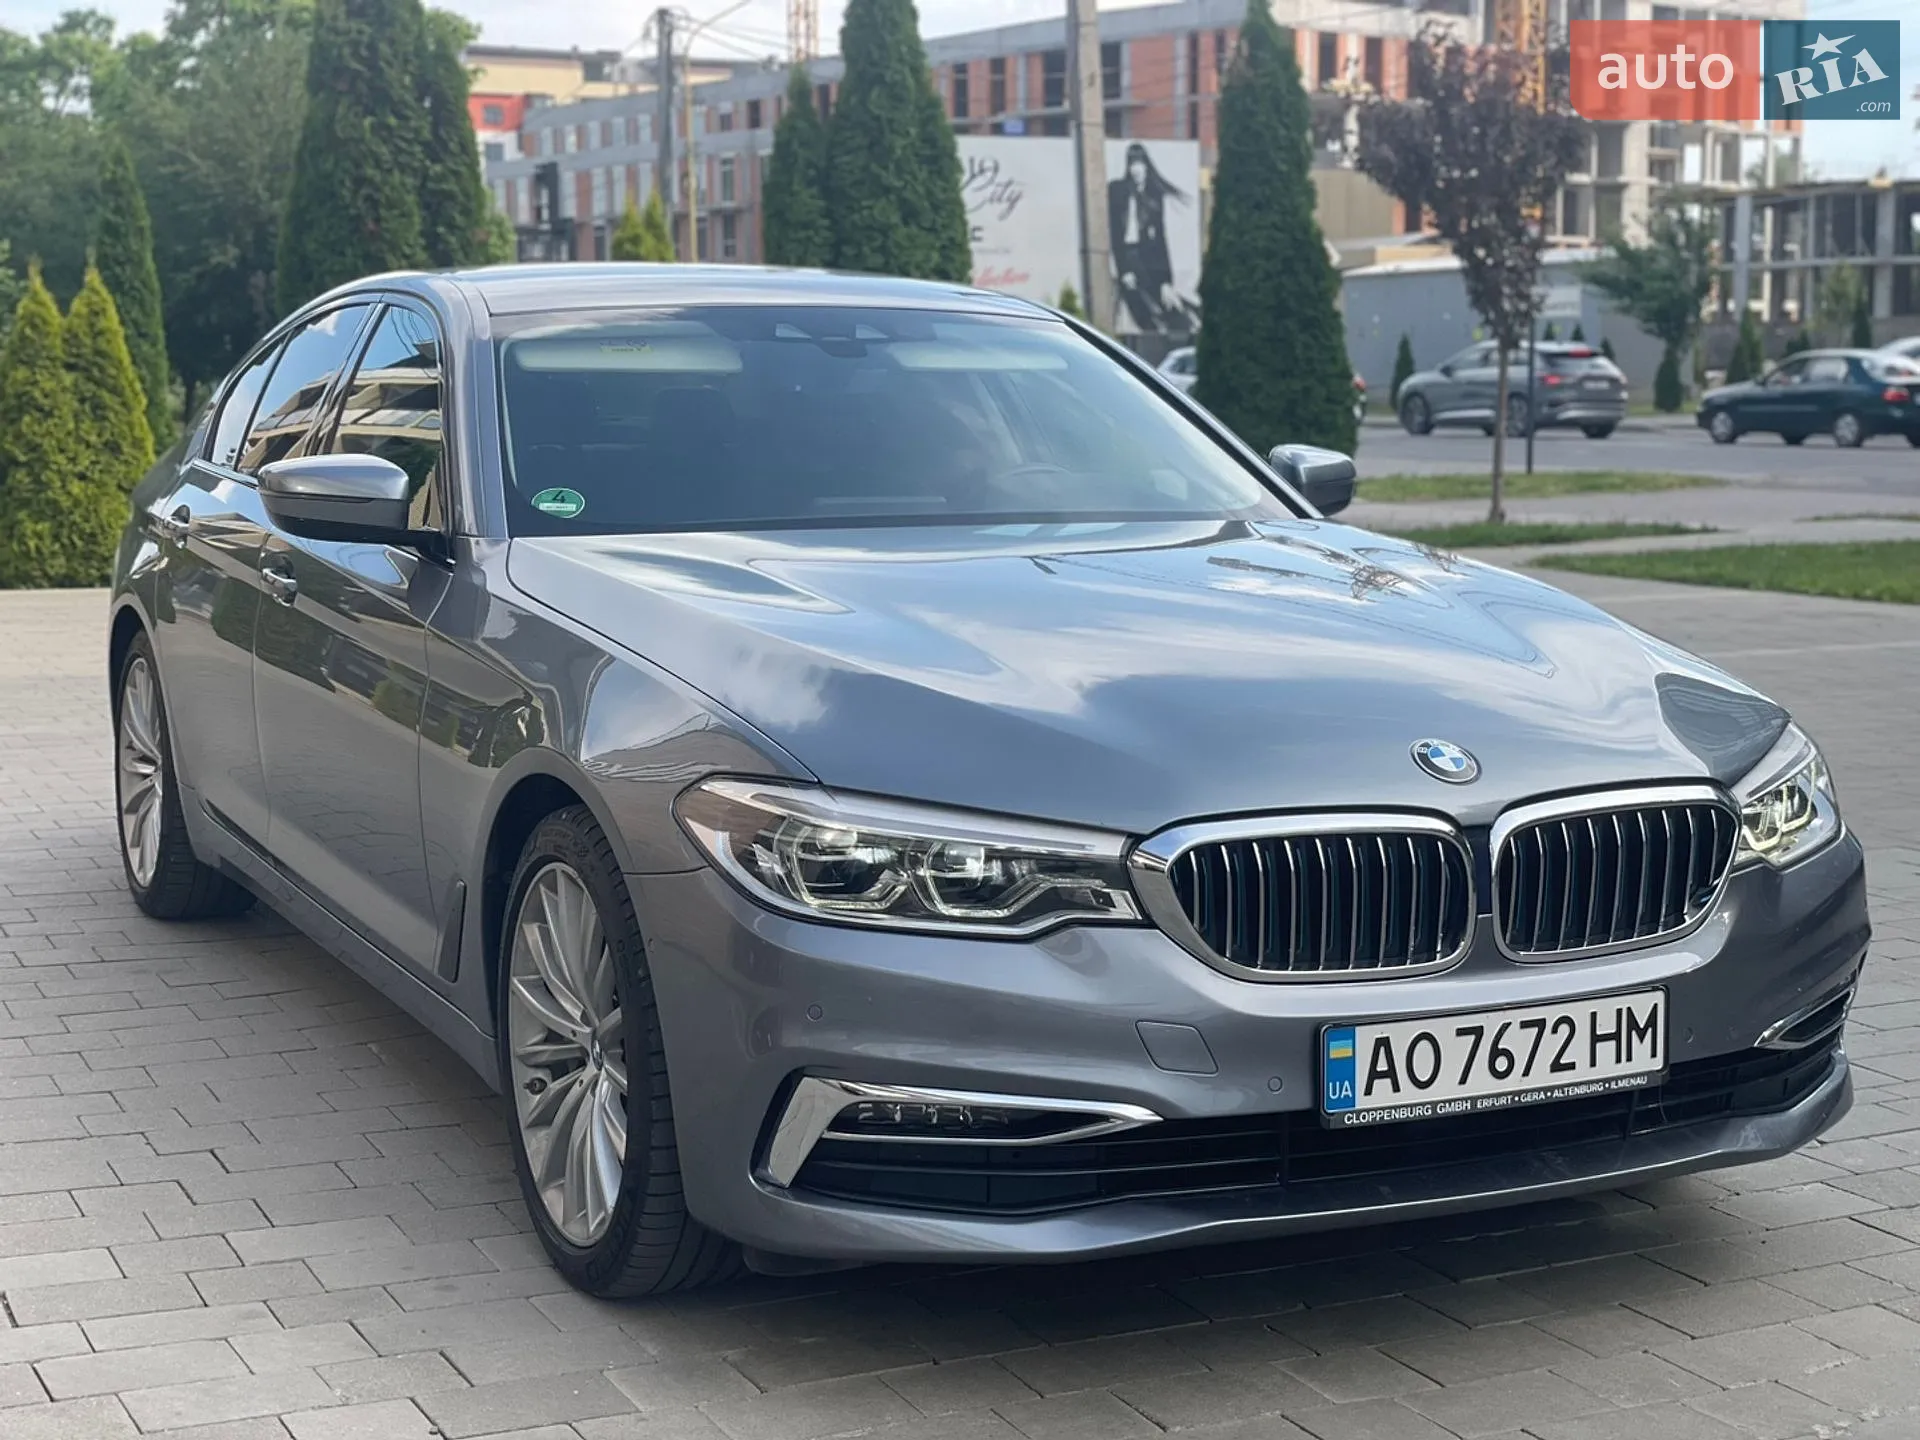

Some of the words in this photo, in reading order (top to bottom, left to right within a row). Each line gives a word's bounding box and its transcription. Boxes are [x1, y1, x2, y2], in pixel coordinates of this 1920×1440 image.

[552, 490, 566, 503] 4
[1455, 1015, 1577, 1085] 7672
[1588, 1003, 1659, 1068] HM
[1328, 1080, 1353, 1100] UA
[1344, 1104, 1432, 1125] CLOPPENBURG
[1436, 1100, 1471, 1114] GMBH
[1477, 1095, 1513, 1109] ERFURT
[1520, 1090, 1546, 1103] GERA
[1552, 1082, 1604, 1099] ALTENBURG
[1610, 1075, 1648, 1090] ILMENAU
